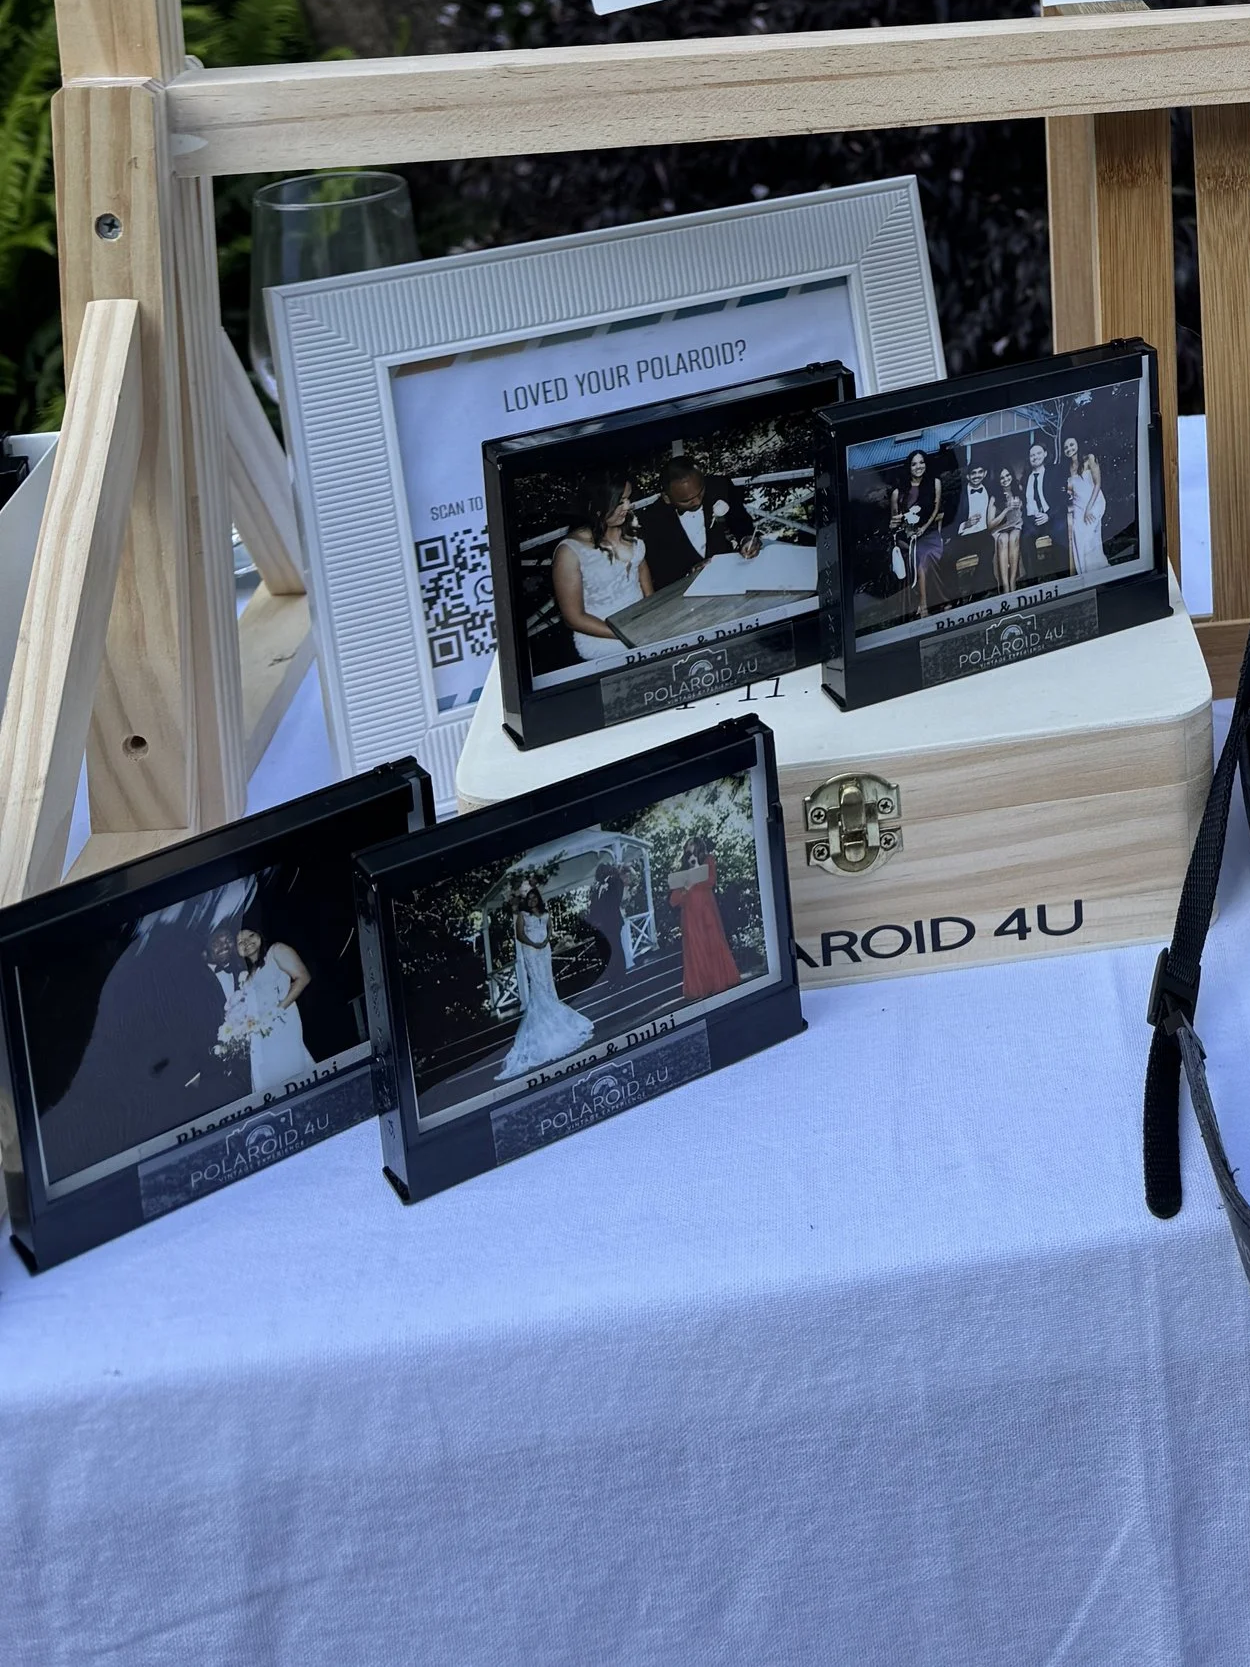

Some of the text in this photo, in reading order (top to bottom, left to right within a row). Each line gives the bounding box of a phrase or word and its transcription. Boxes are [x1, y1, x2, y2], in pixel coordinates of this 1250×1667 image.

[504, 339, 746, 412] LOVED YOUR POLAROID?
[430, 496, 484, 521] SCAN TO
[960, 623, 1064, 668] POLAROID 4U
[644, 658, 758, 706] POLAROID 4U
[993, 899, 1084, 940] 4U
[540, 1066, 668, 1134] POLAROID 4U
[190, 1114, 329, 1188] POLAROID 4U
